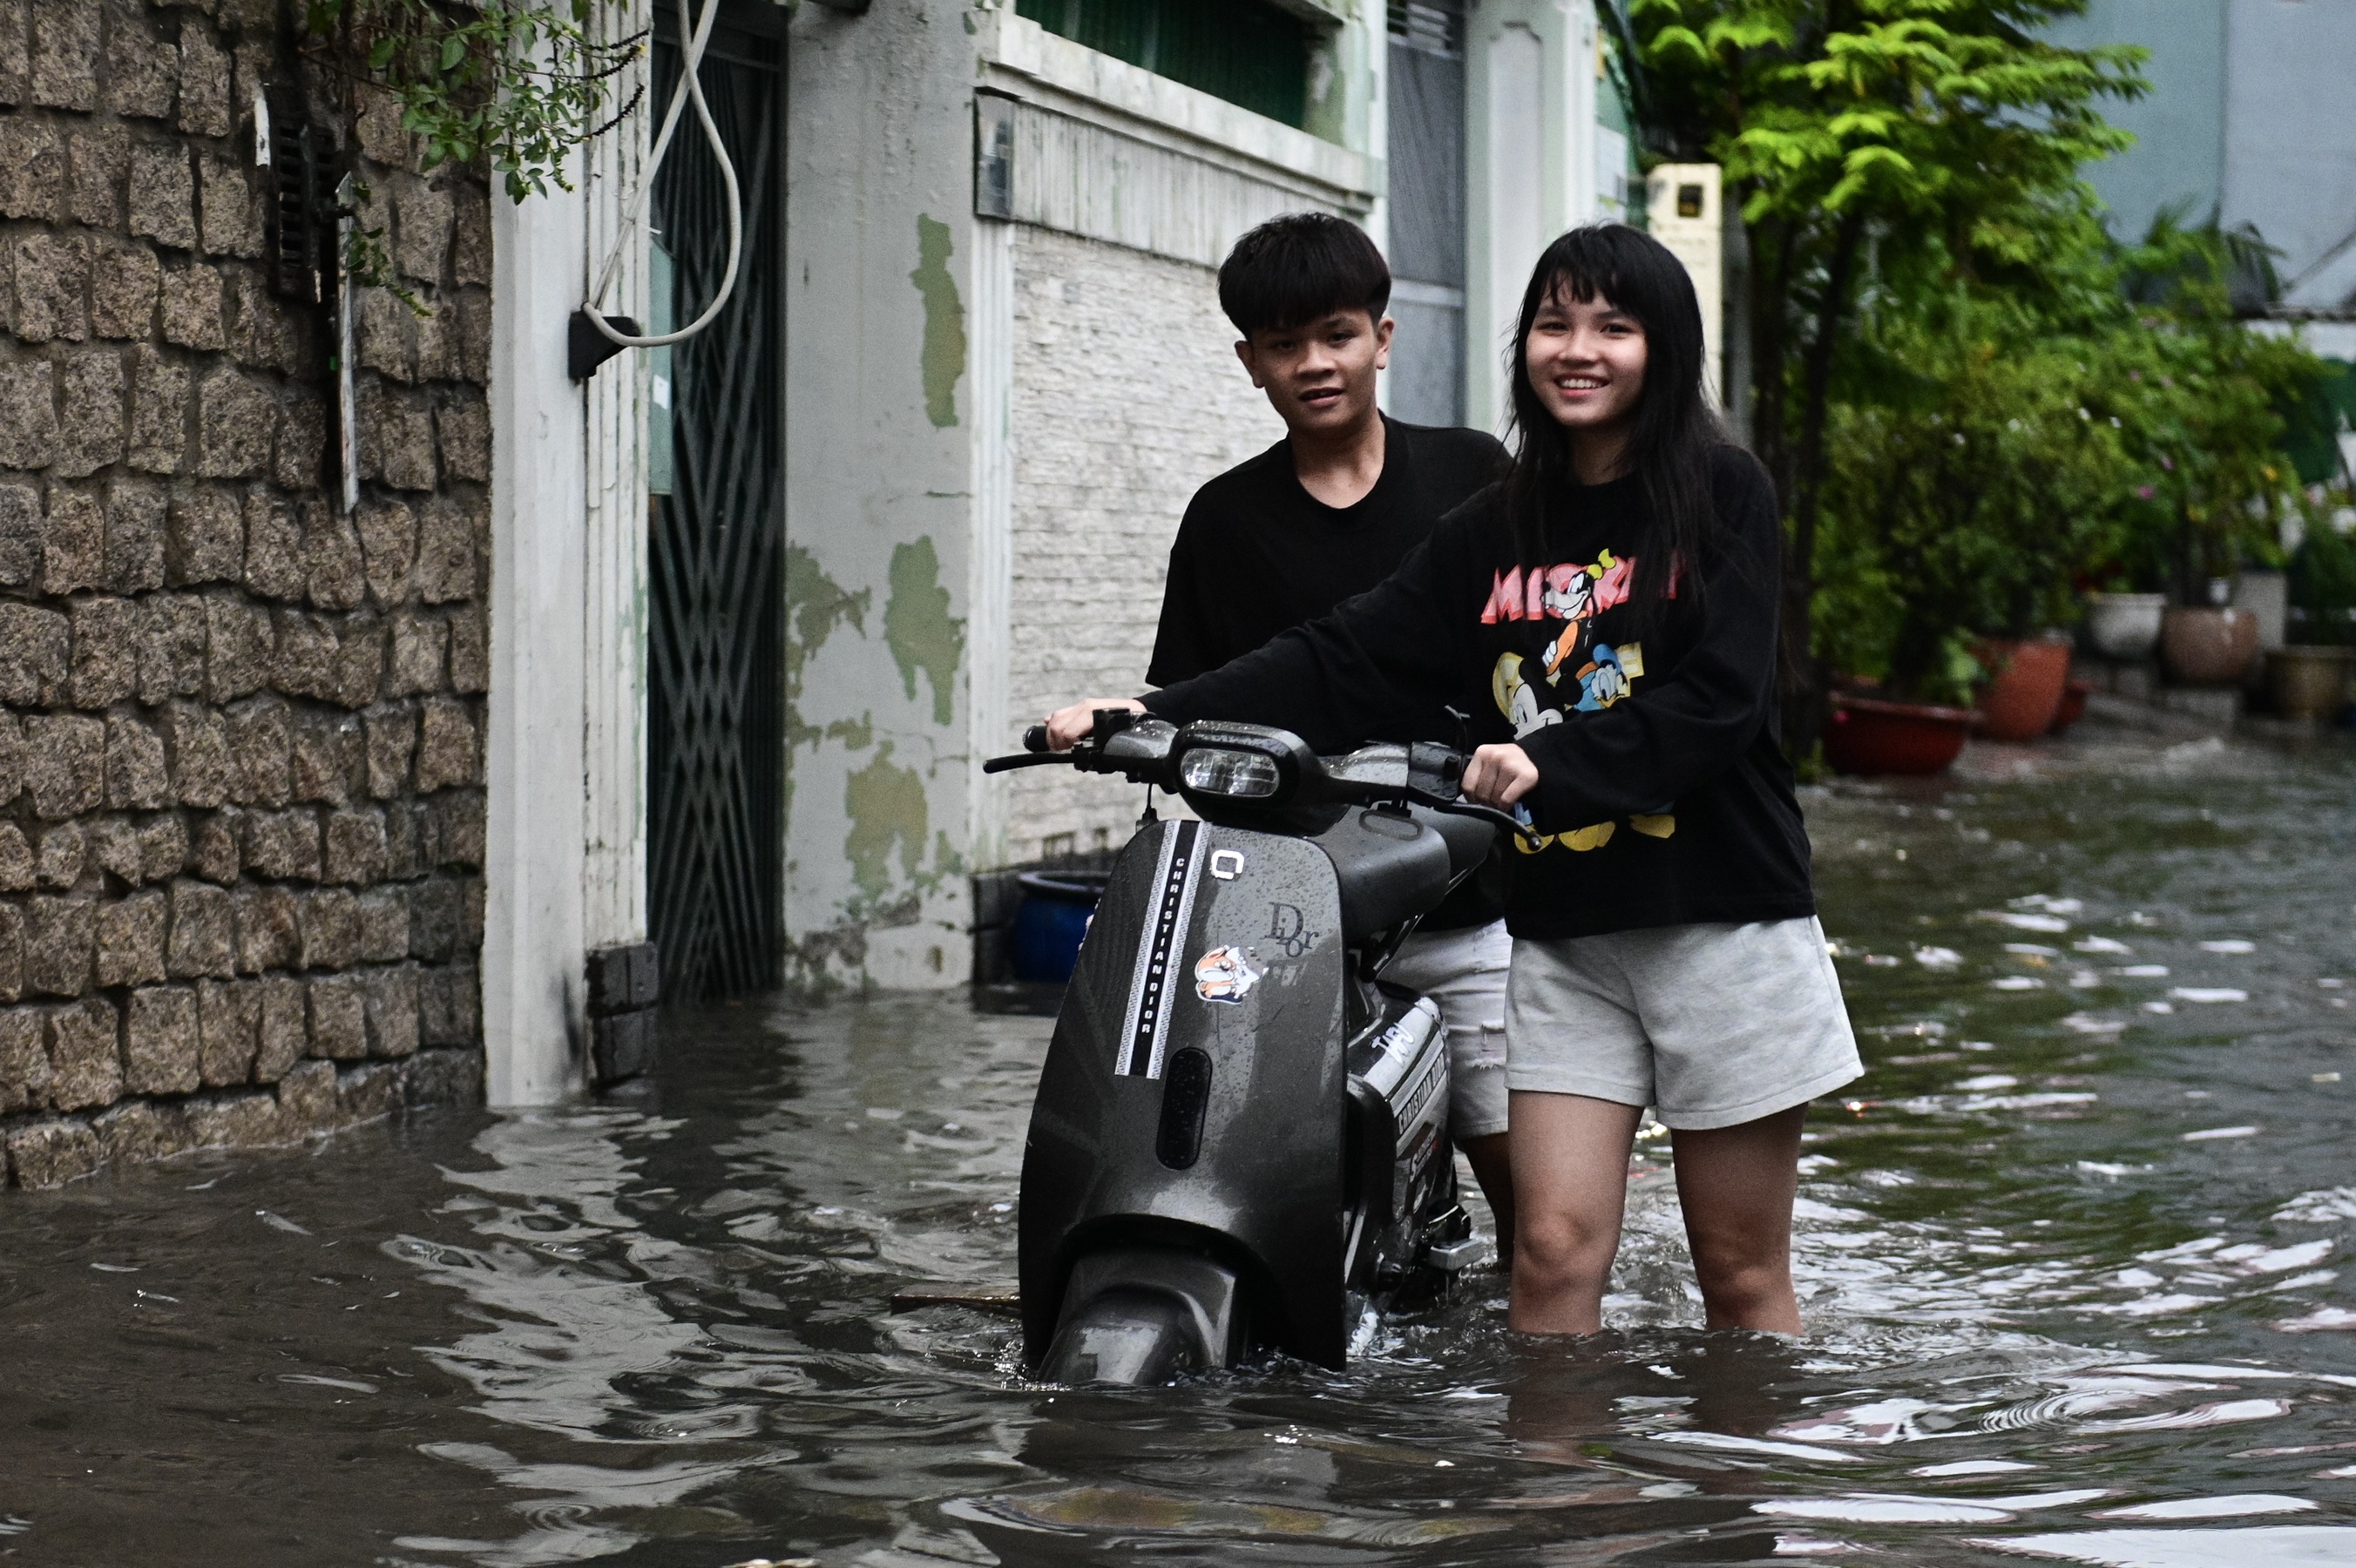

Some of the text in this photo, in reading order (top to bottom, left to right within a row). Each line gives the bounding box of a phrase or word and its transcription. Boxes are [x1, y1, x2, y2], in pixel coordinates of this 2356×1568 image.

[1480, 549, 1687, 625] MICK
[1141, 857, 1186, 1034] CHRISTIAN DIOR
